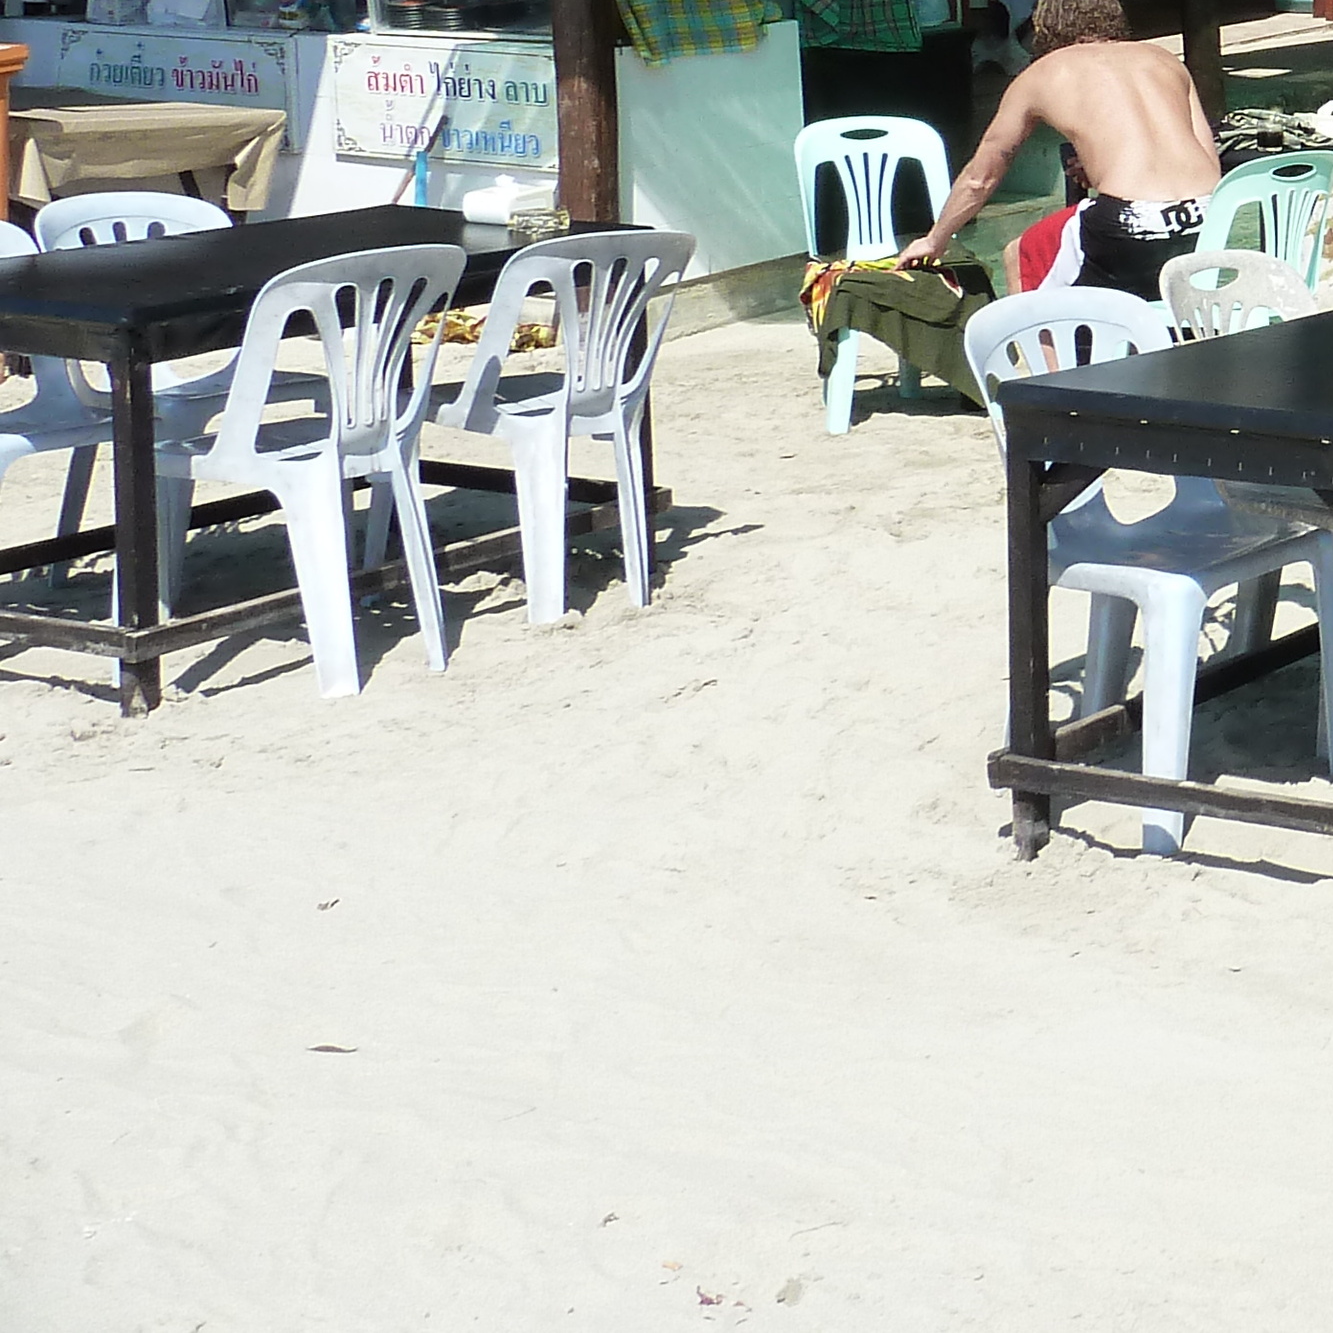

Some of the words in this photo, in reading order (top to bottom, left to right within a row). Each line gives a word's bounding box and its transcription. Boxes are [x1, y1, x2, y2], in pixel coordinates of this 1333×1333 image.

[89, 41, 166, 87] ก๋วยเตี๋ยว
[172, 55, 259, 94] ข้าวมันไก่
[366, 55, 426, 96] ส้มตำ
[429, 60, 496, 101] ไก่ย่าง
[504, 79, 548, 105] ลาบ
[380, 99, 431, 146] น้ำตก
[441, 118, 542, 157] ขาวเหนียว
